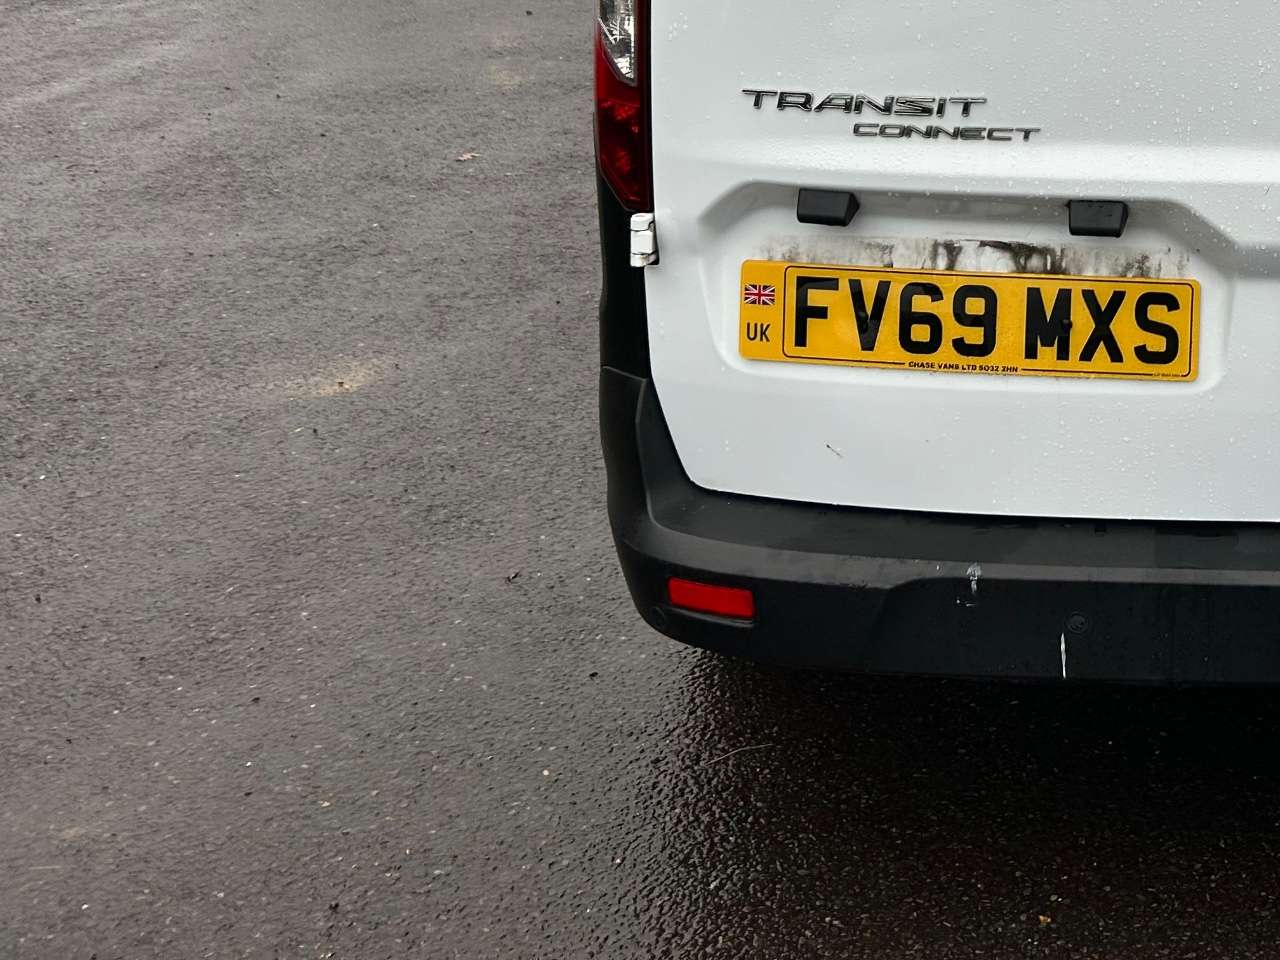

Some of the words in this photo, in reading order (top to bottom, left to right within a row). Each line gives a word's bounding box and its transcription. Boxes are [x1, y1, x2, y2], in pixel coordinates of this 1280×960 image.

[741, 89, 987, 118] TRANSIT
[853, 123, 1041, 142] CONNECT
[794, 276, 998, 358] FV69
[1024, 287, 1181, 365] MXS
[746, 322, 771, 343] UK
[908, 361, 935, 369] CHASE
